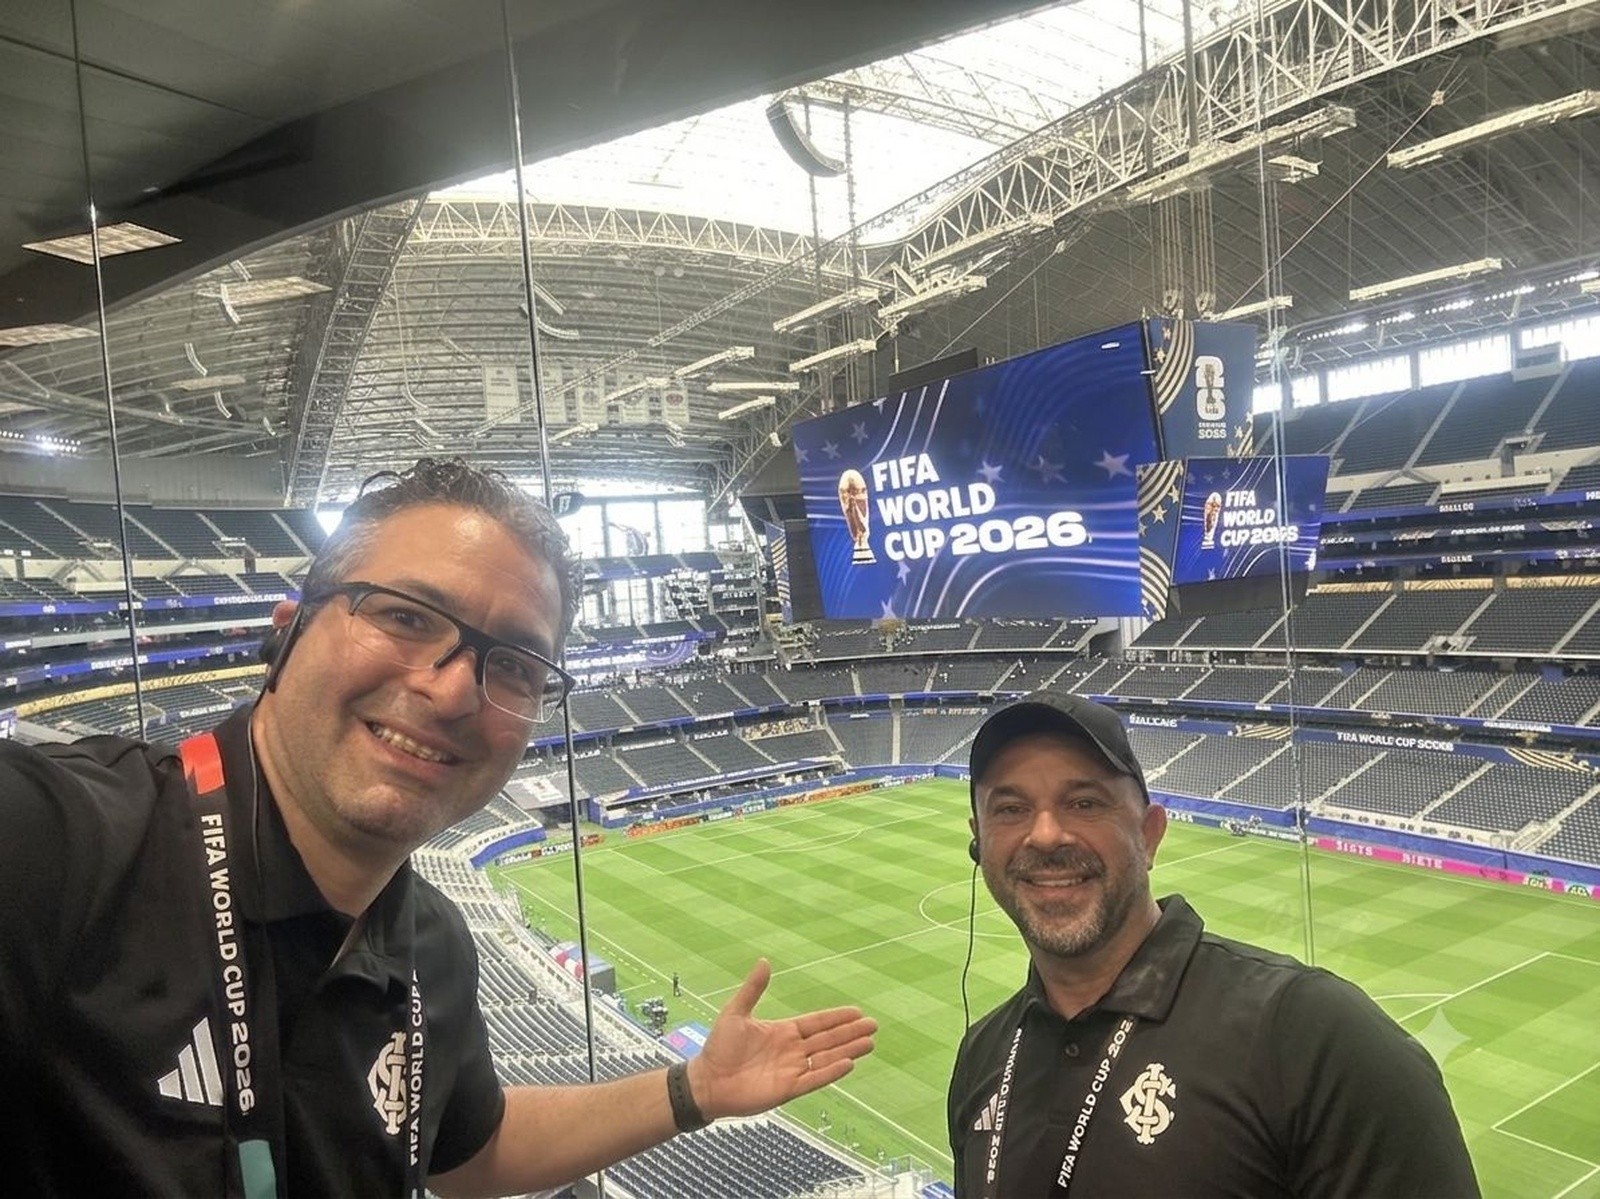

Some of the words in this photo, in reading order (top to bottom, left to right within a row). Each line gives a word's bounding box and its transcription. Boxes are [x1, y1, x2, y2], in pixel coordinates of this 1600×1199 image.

[872, 453, 940, 492] FIFA
[876, 482, 996, 527] WORLD
[1223, 508, 1275, 527] WORLD
[1225, 490, 1256, 508] FIFA
[884, 527, 945, 562] CUP
[951, 511, 1087, 556] 2026
[1220, 529, 1250, 547] CUP
[1395, 737, 1416, 748] CUP
[201, 813, 228, 866] FIFA
[209, 867, 238, 961] WORLD
[223, 964, 246, 1017] CUP
[231, 1021, 255, 1113] 2026
[410, 1031, 424, 1115] WORLD
[1068, 1093, 1097, 1152] WORLD
[1091, 1058, 1111, 1093] CUP
[1107, 1019, 1133, 1059] 202
